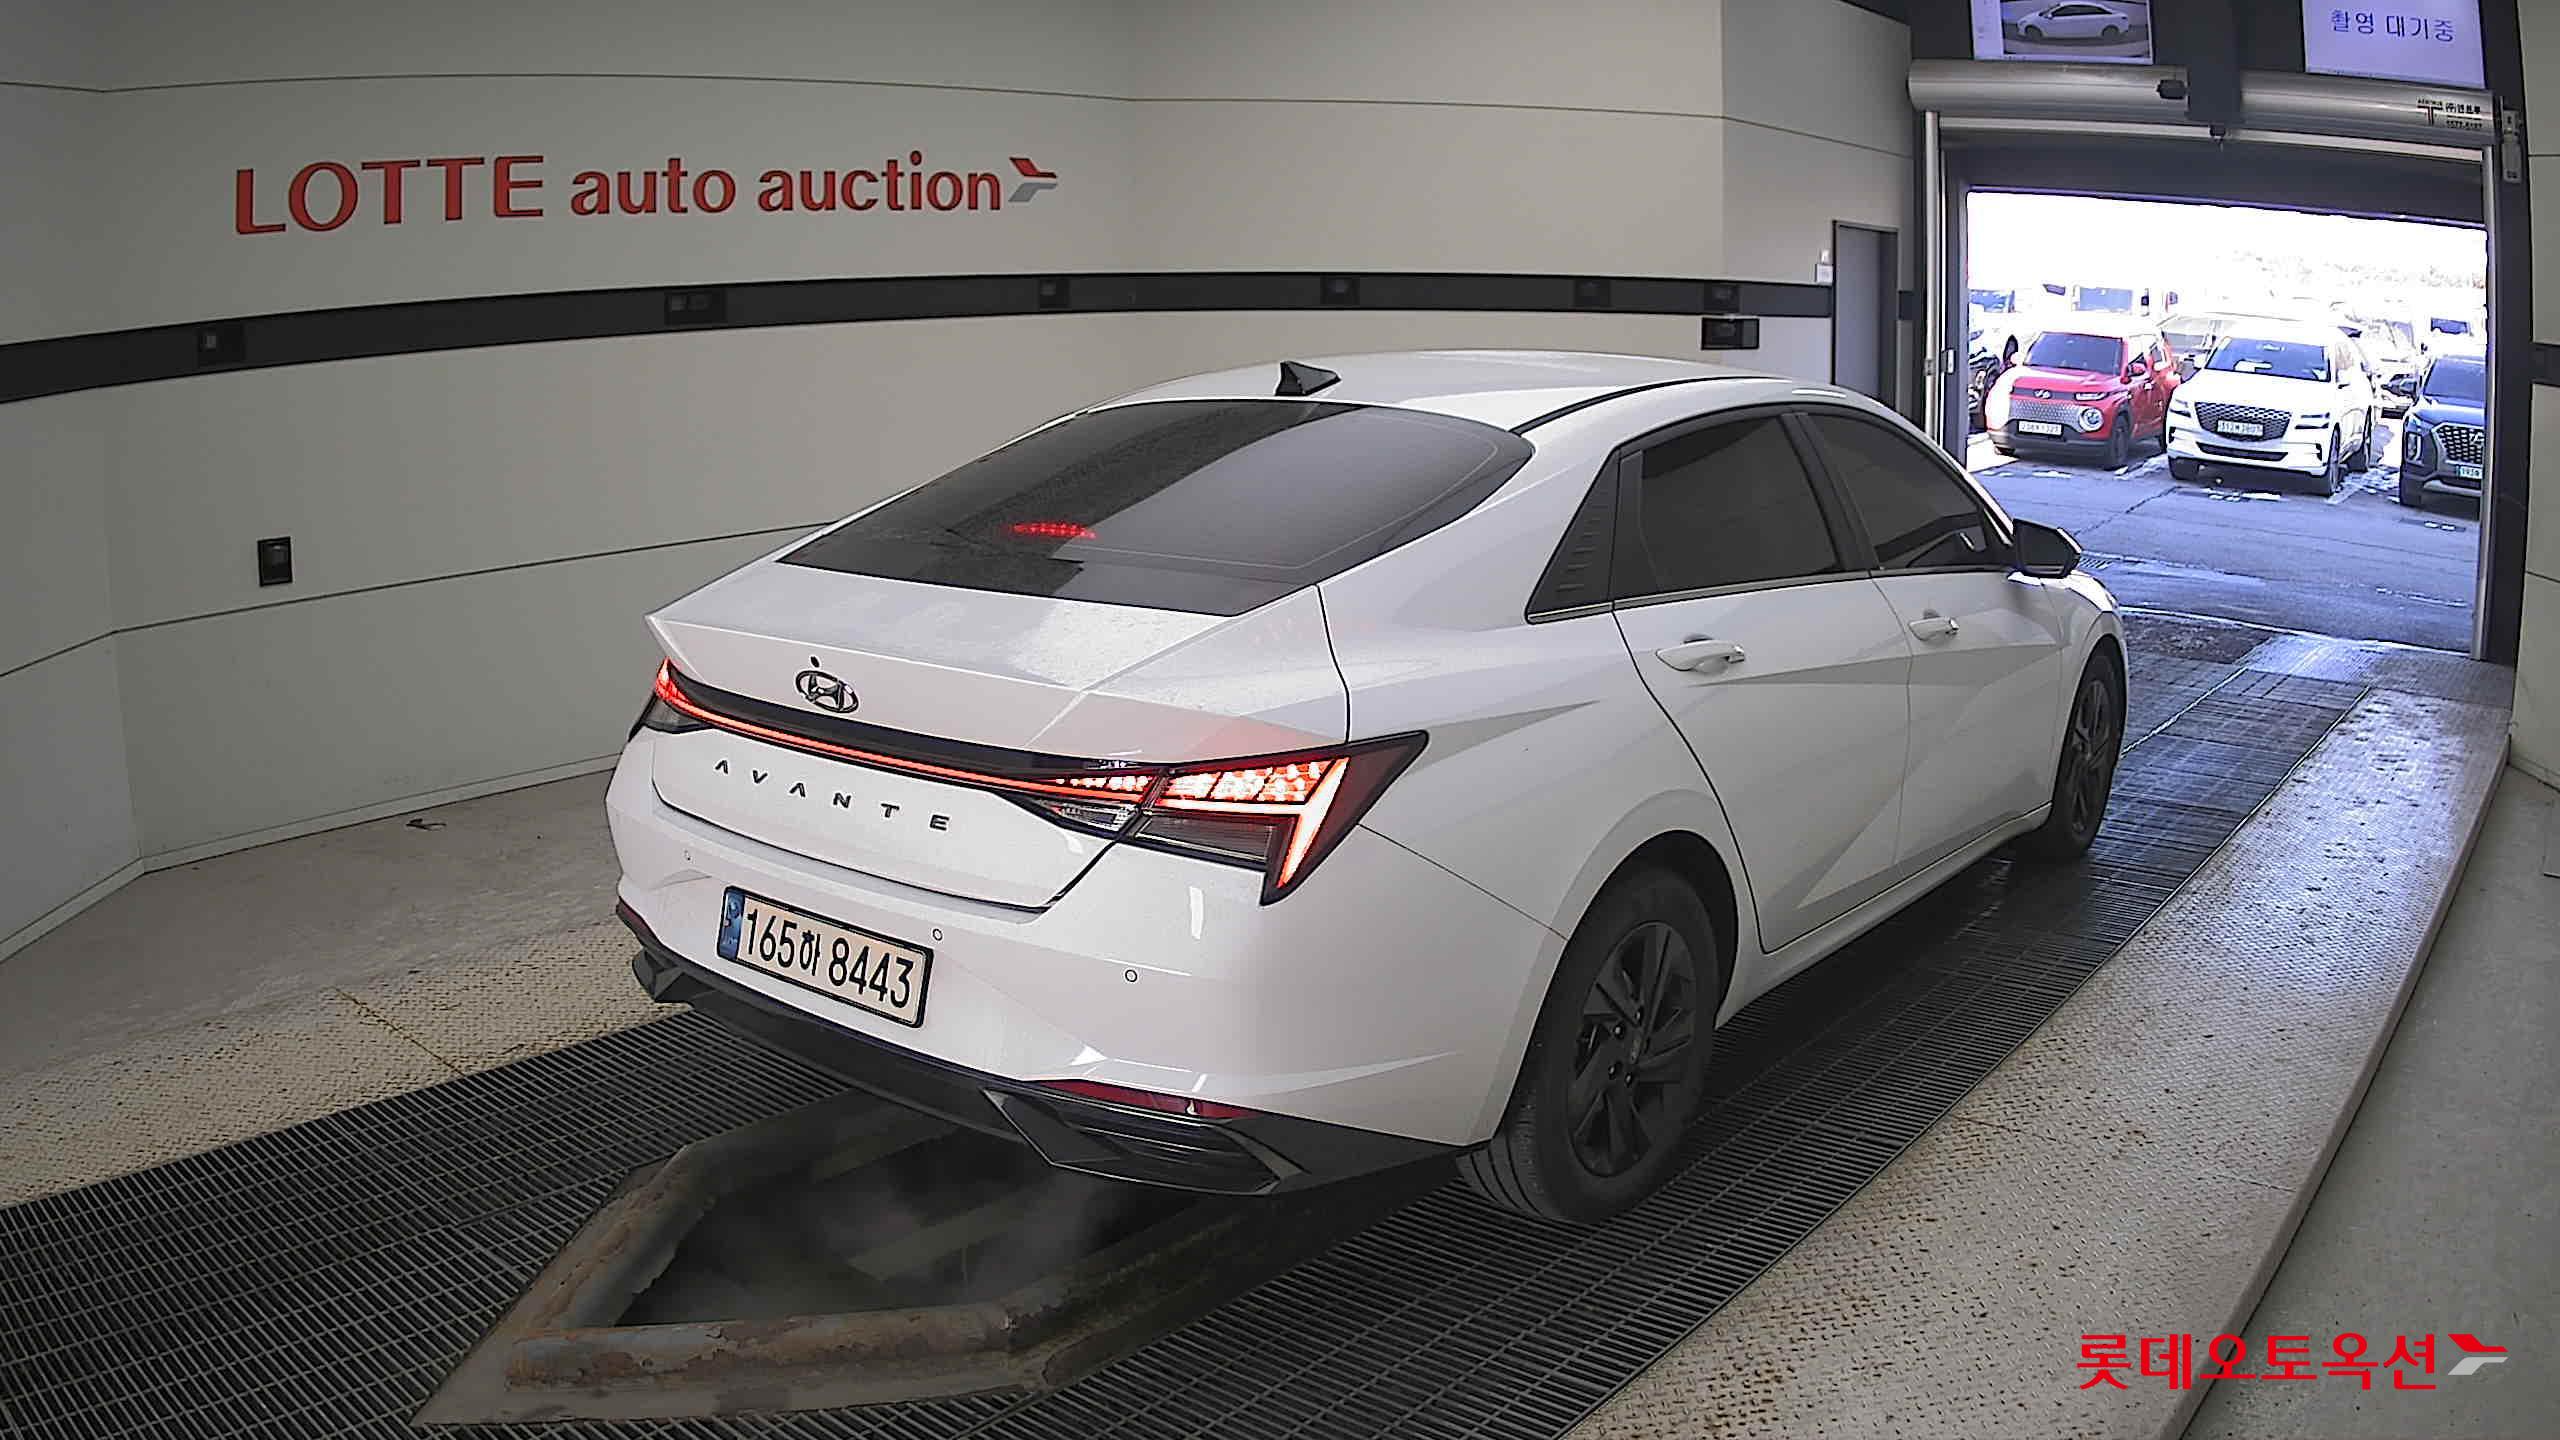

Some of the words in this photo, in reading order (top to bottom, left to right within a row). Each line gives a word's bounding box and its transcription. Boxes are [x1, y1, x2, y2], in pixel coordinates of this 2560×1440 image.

[2331, 9, 2374, 35] 촬영
[2386, 15, 2453, 42] 대기중
[236, 155, 543, 235] LOTTE
[571, 159, 737, 216] auto
[758, 152, 1004, 213] auction
[714, 758, 951, 832] AVANTE
[746, 907, 821, 977] 165하
[828, 937, 914, 1009] 8443
